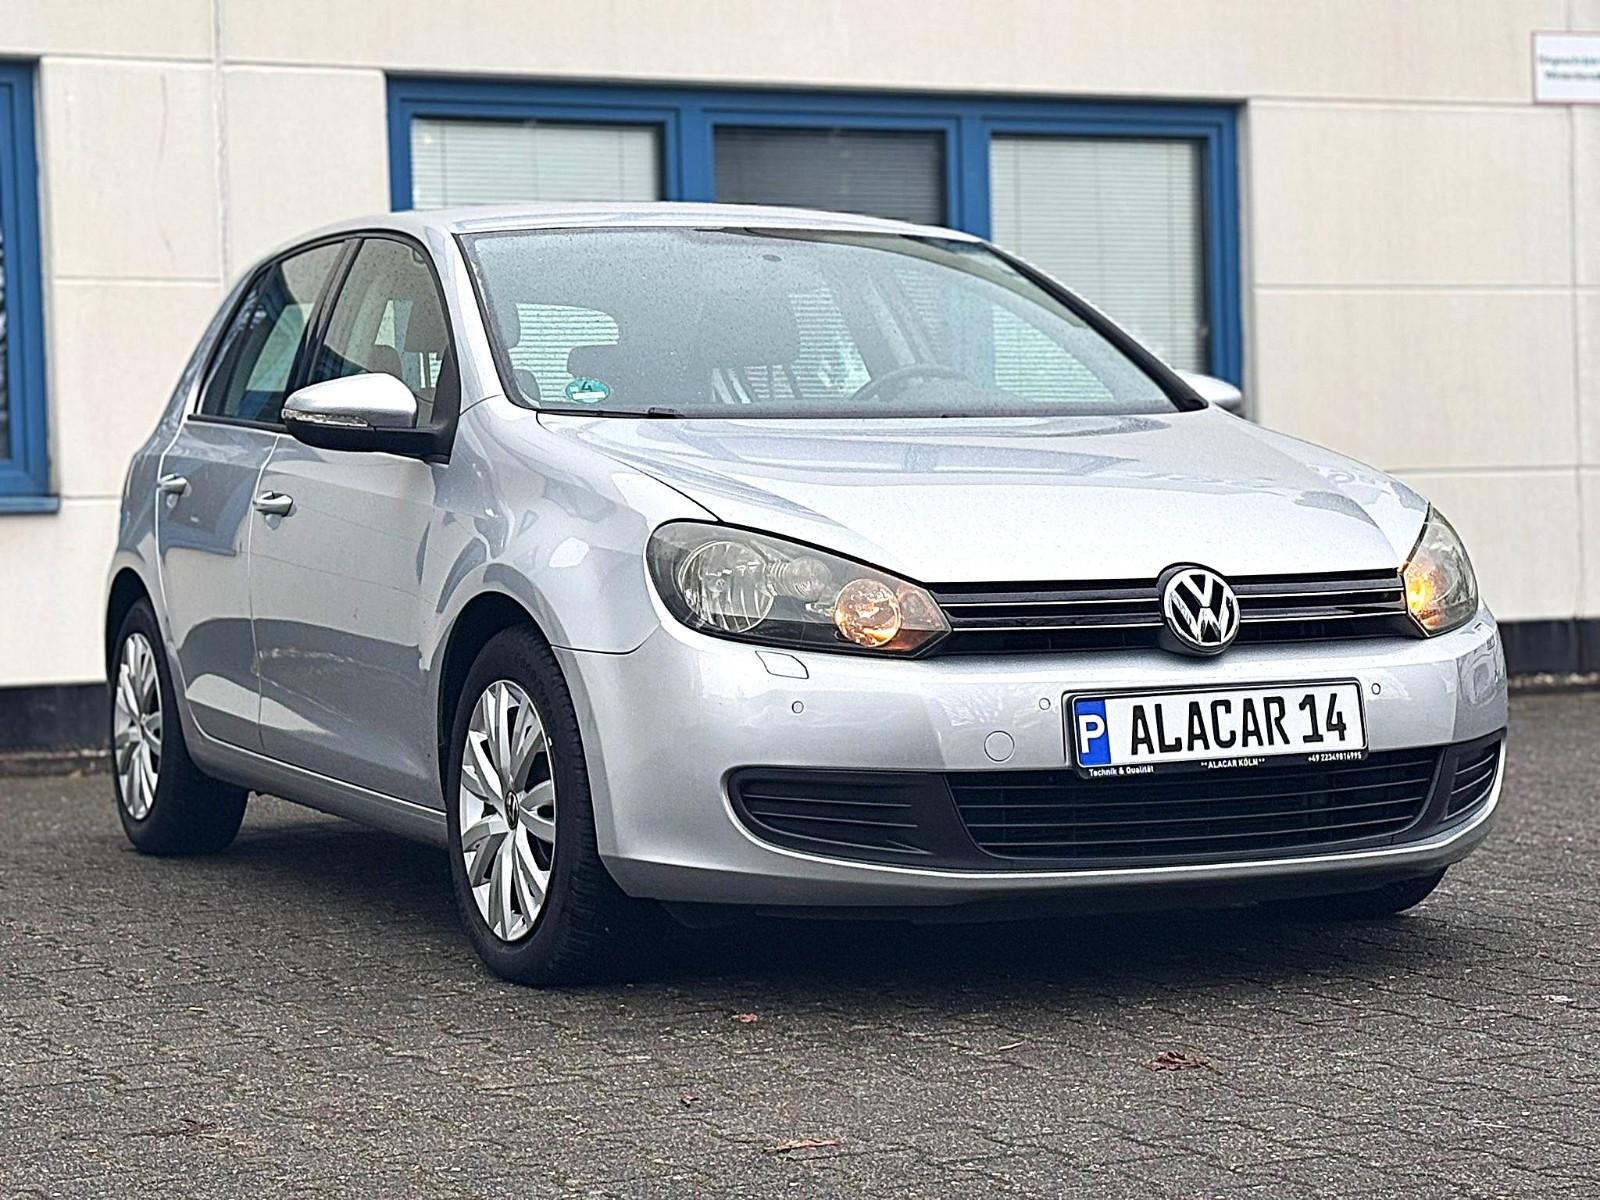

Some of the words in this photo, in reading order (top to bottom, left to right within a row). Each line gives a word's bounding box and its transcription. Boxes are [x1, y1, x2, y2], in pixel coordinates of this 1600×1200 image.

[581, 381, 593, 392] 4
[1164, 568, 1240, 647] VW
[1078, 714, 1106, 754] P
[1130, 696, 1290, 756] ALACAR
[1299, 693, 1347, 744] 14
[1307, 753, 1320, 762] +49
[1089, 767, 1117, 777] Technik
